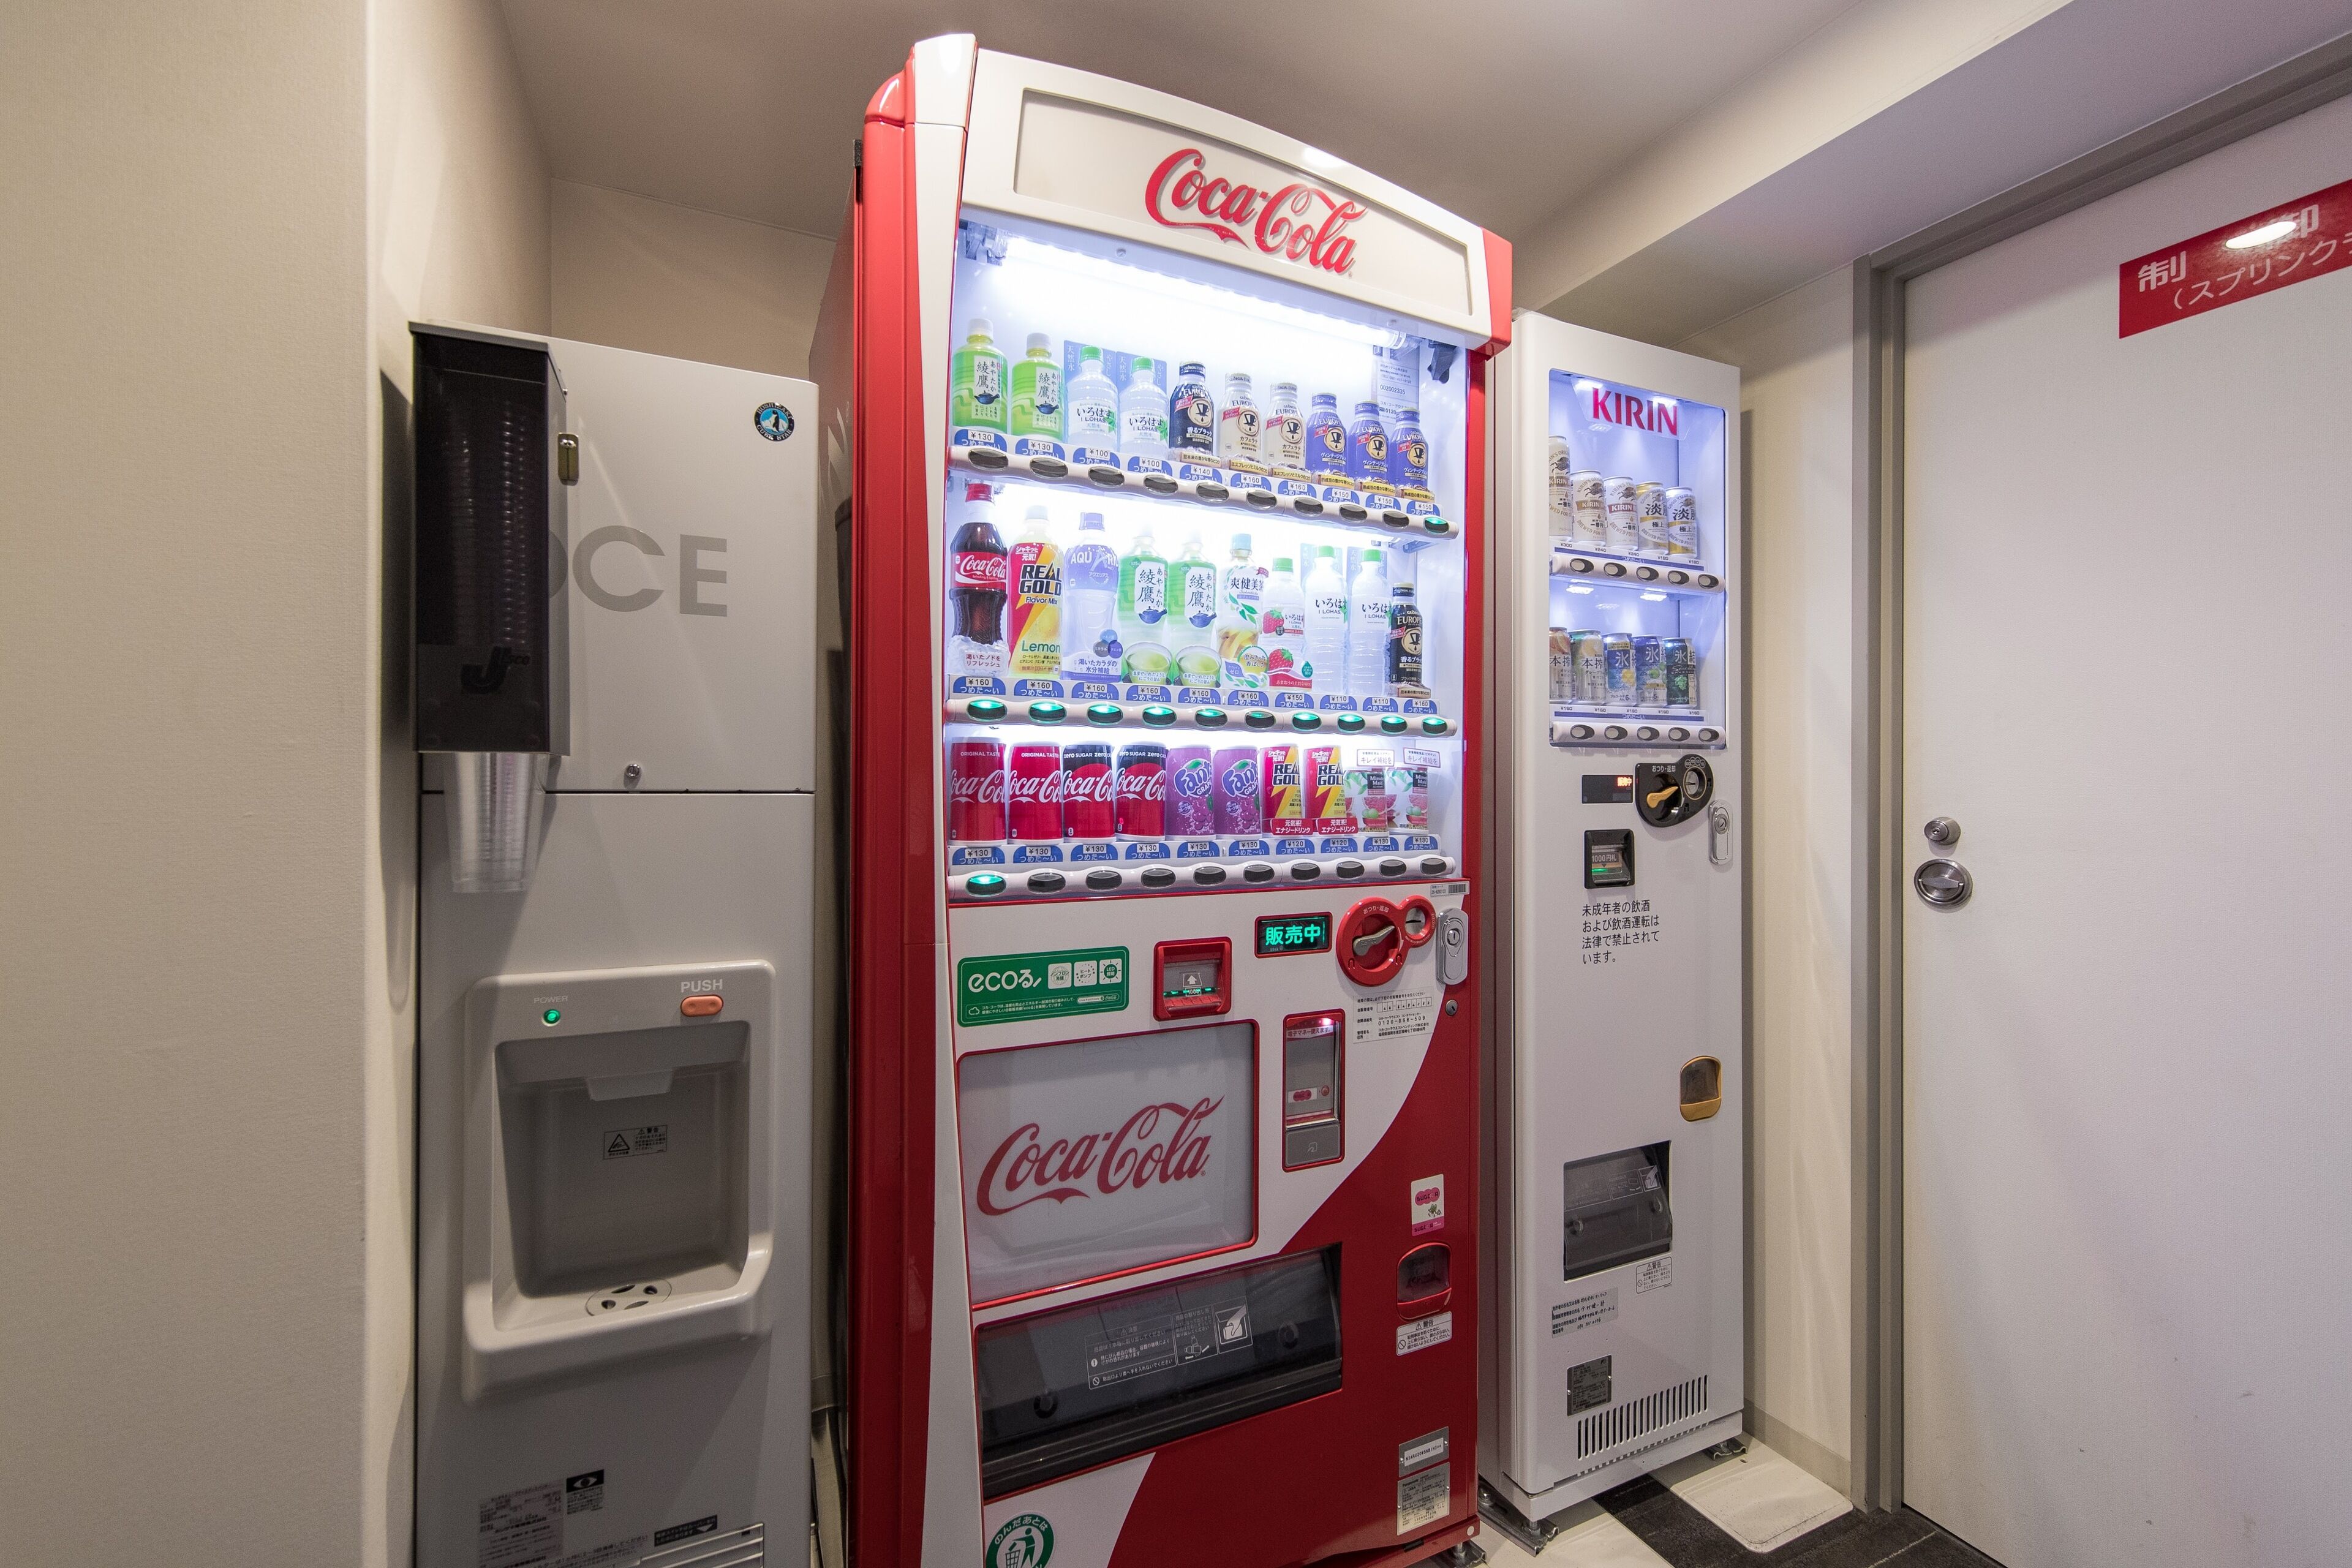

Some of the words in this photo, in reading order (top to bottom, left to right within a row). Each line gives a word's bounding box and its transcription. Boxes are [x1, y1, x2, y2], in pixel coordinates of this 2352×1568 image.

[1145, 148, 1366, 274] Coca-Cola
[976, 361, 990, 388] 綾鷹
[1038, 373, 1050, 398] 綾鷹
[757, 402, 793, 419] HOSHIZAKI
[1077, 407, 1112, 419] いろはす
[1593, 387, 1678, 435] KIRIN
[1129, 417, 1164, 427] いろはす
[757, 424, 774, 440] CUBE
[777, 429, 792, 440] STAR
[971, 432, 992, 441] ¥130
[1031, 442, 1050, 451] ¥130
[960, 554, 1006, 578] Coca-Cola
[1022, 562, 1062, 582] REAL
[1019, 579, 1062, 595] GOLD
[1136, 569, 1156, 603] 綾鷹
[1187, 574, 1207, 608] 綾鷹
[1025, 595, 1047, 605] Flavor
[1022, 640, 1060, 653] Lemon
[966, 653, 1001, 662] 渇いたノドを
[1078, 658, 1117, 667] 渇いたカラダの
[1408, 755, 1438, 765] キレイ補給を
[1582, 899, 1651, 917] 未成年者の飲酒
[1582, 915, 1660, 933] および飲酒運転は
[1265, 924, 1321, 946] 販売中
[1582, 930, 1660, 949] 法律で禁止されて
[1583, 950, 1617, 965] います。
[680, 979, 723, 993] PUSH
[533, 995, 568, 1004] POWER
[976, 1095, 1225, 1216] Coca-Cola
[995, 1516, 1049, 1545] のんだあとは
